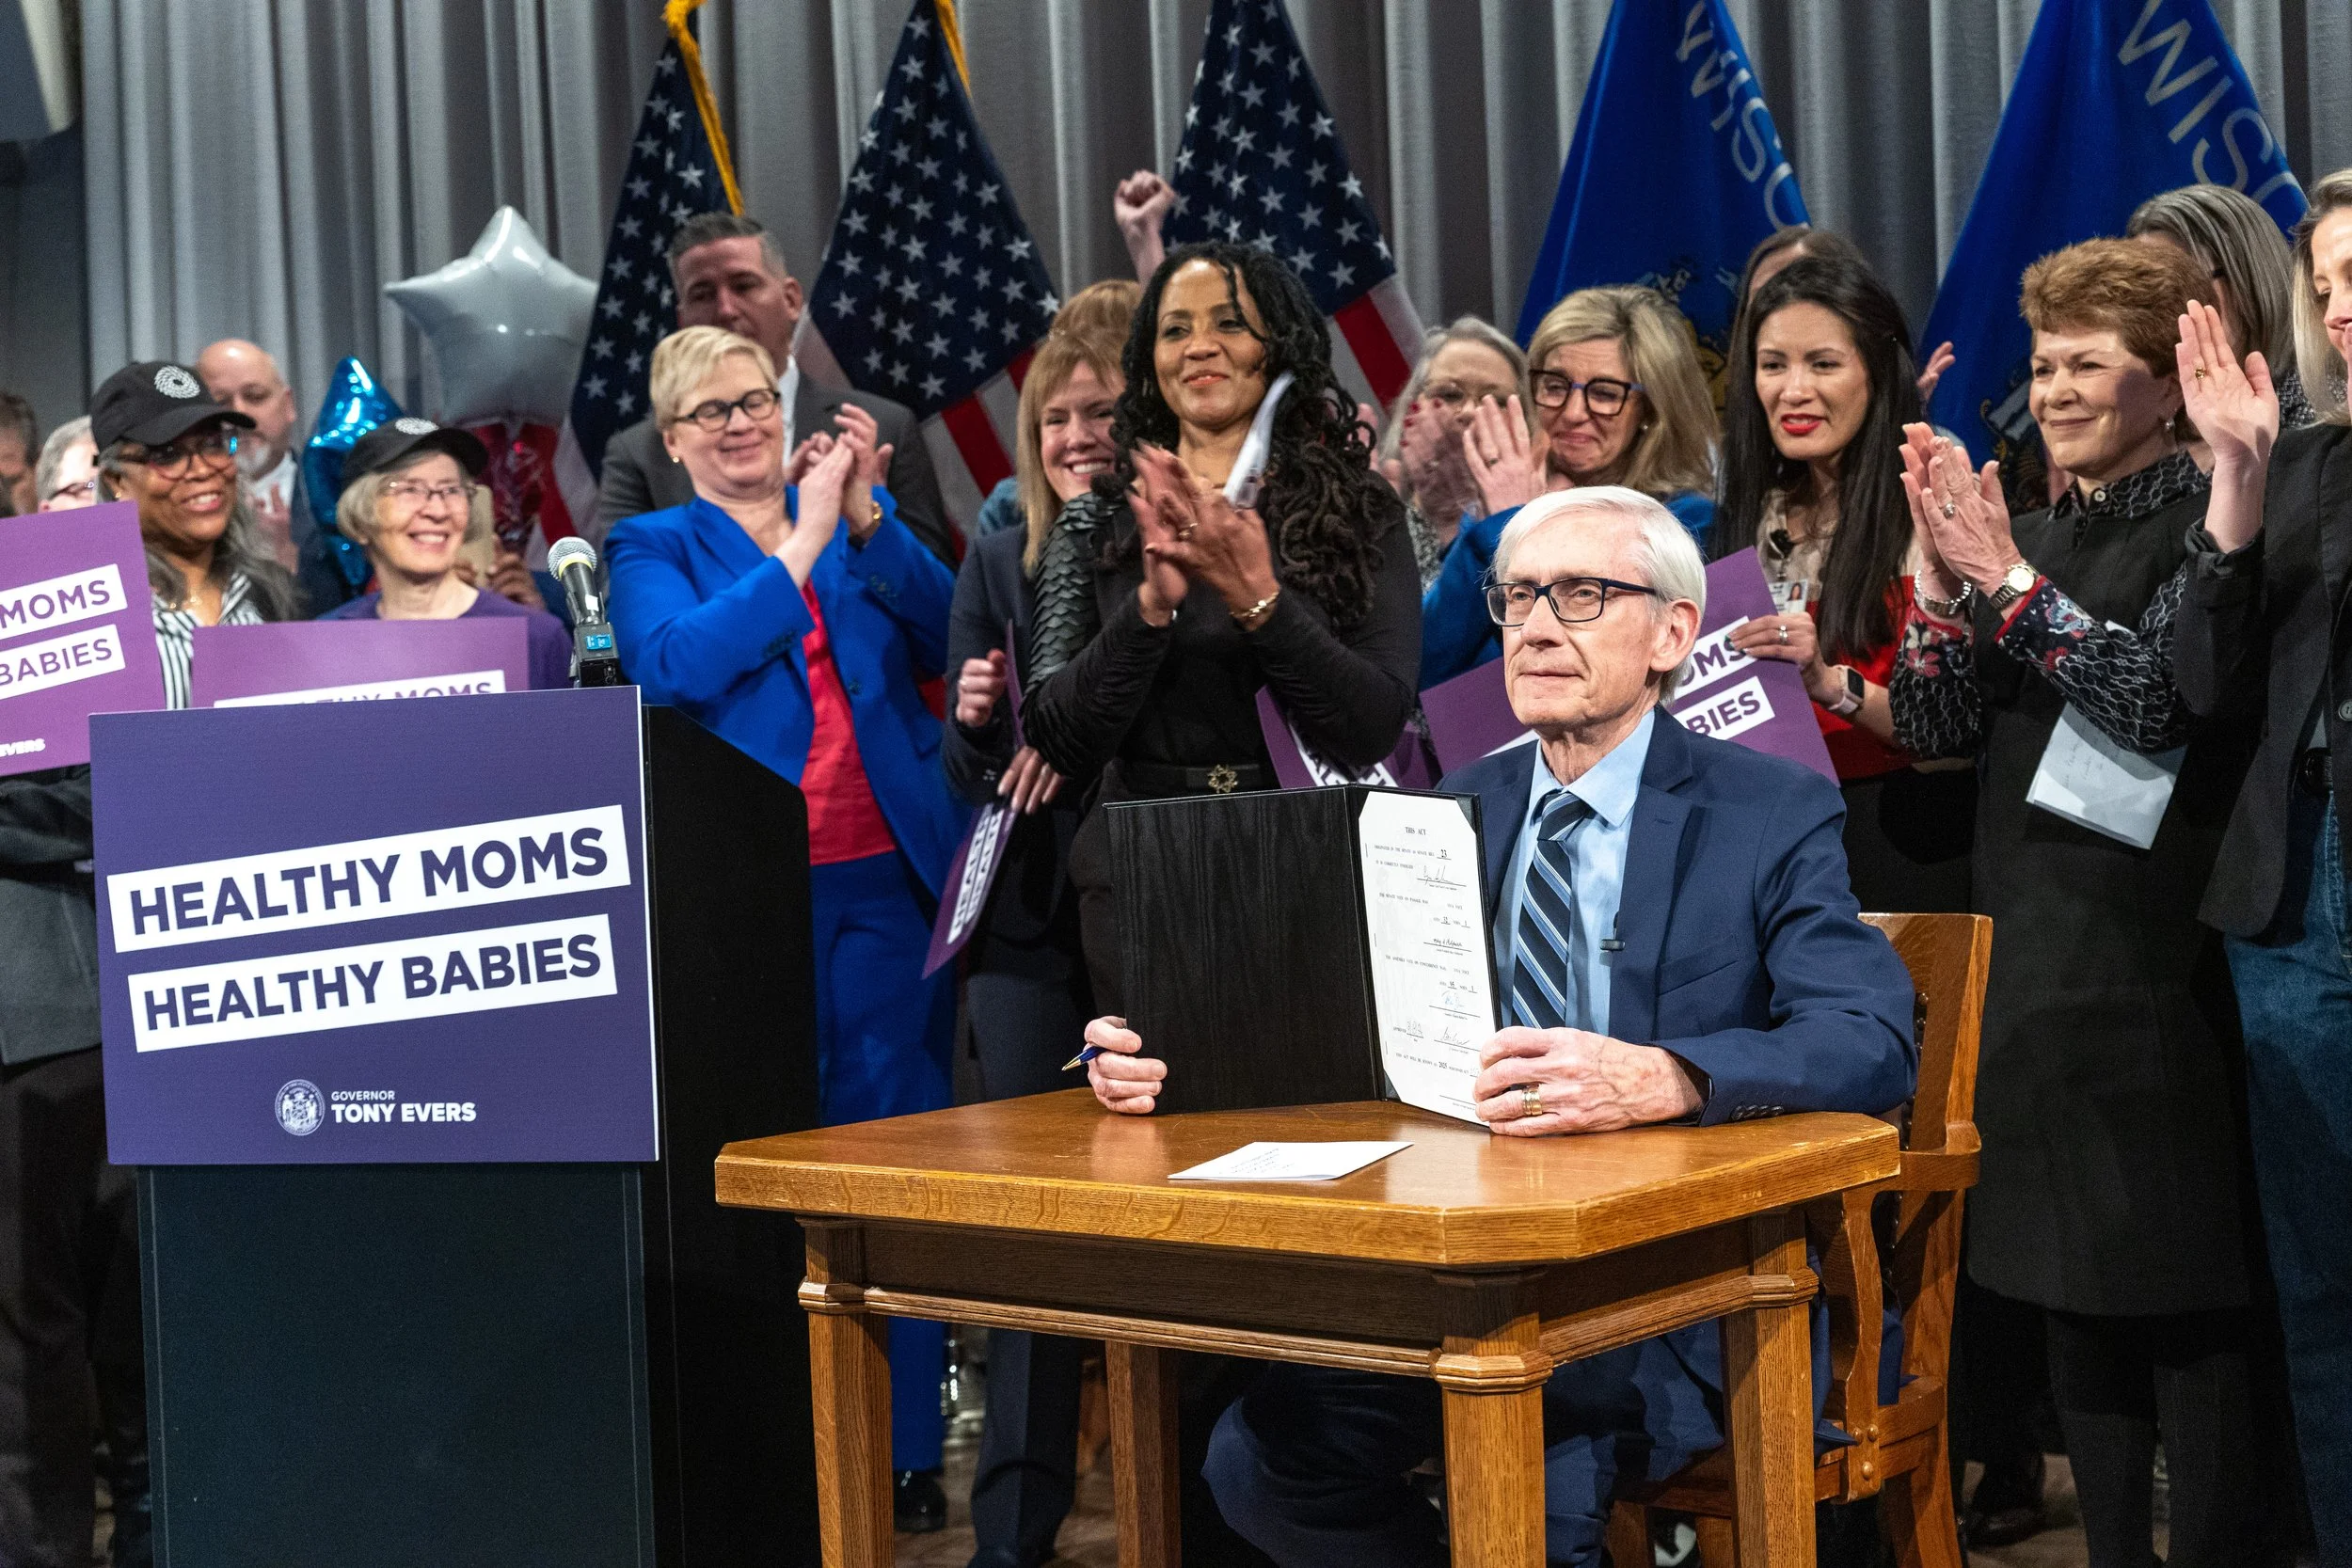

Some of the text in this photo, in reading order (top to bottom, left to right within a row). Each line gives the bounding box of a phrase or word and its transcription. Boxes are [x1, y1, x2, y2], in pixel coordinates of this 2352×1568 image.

[0, 580, 111, 629] MOMS
[0, 639, 112, 687] BABIES
[1686, 690, 1761, 736] BIES
[130, 827, 608, 935] HEALTHY MOMS
[144, 933, 601, 1031] HEALTHY BABIES
[330, 1090, 396, 1101] GOVERNOR
[331, 1101, 477, 1123] TONY EVERS
